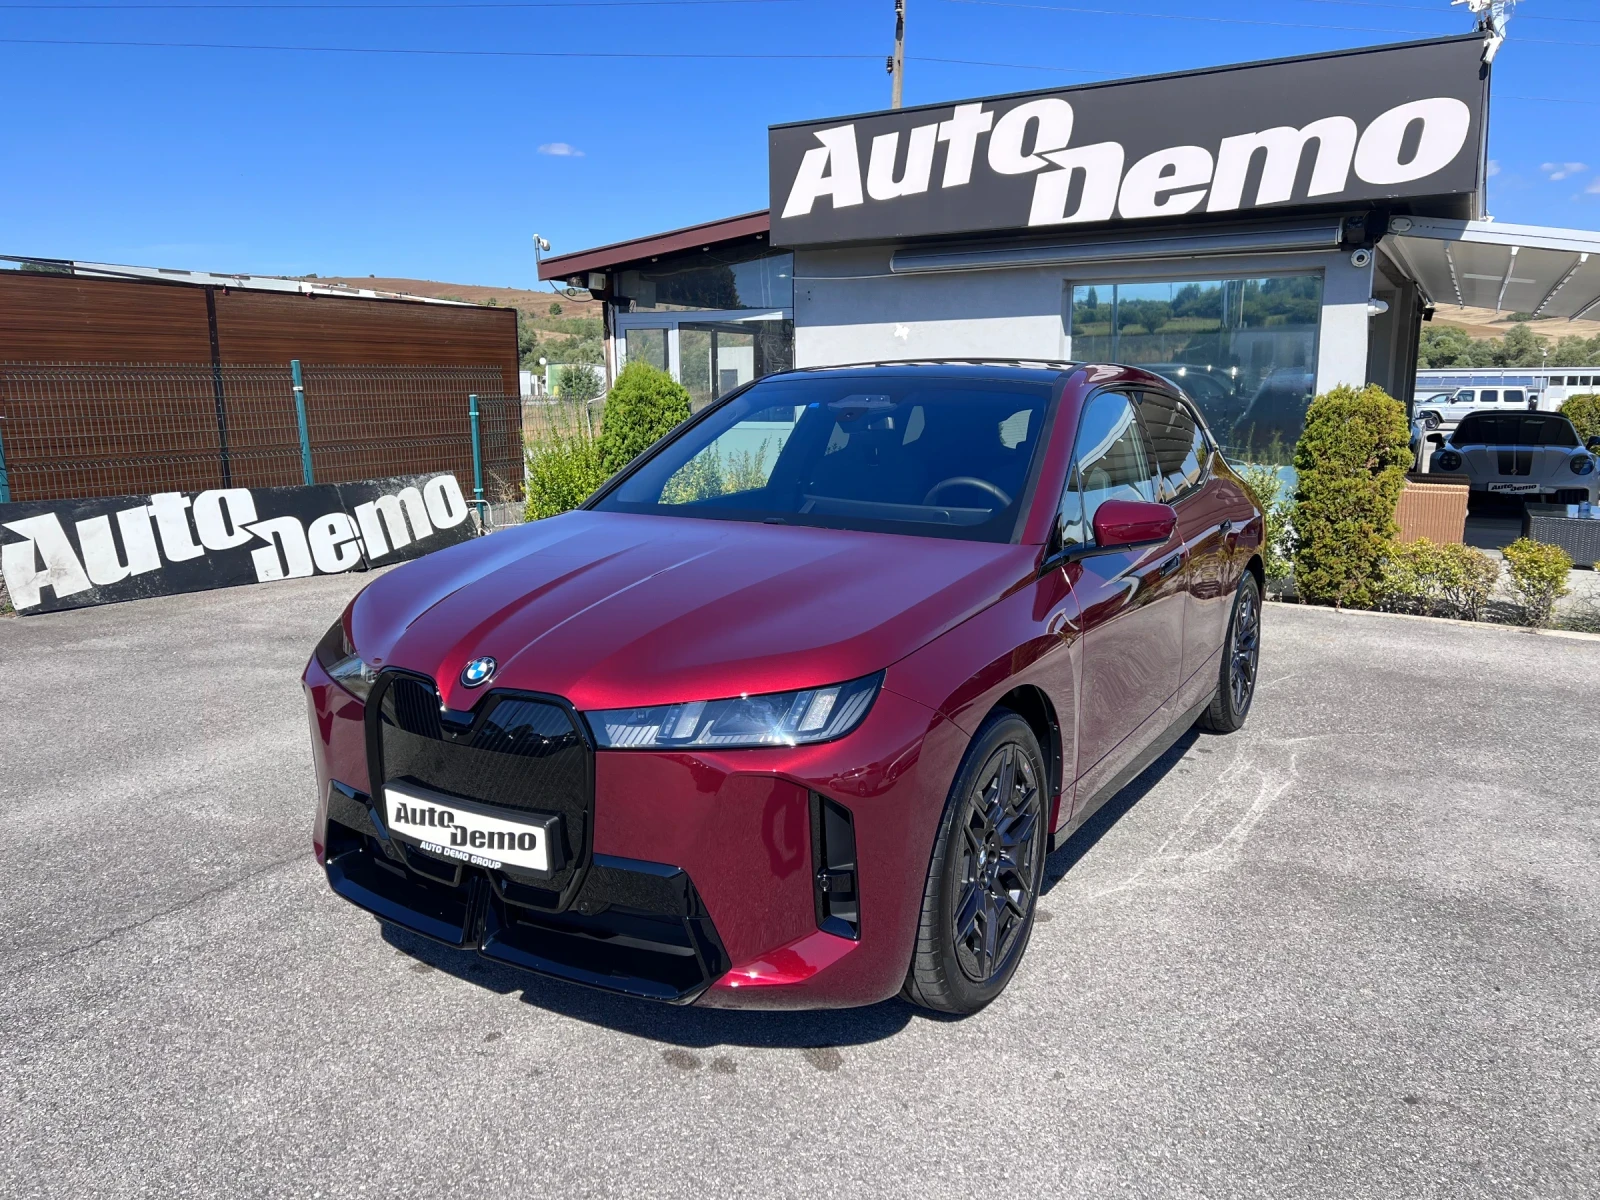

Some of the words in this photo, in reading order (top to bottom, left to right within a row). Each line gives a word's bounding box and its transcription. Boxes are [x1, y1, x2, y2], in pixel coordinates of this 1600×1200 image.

[781, 98, 1075, 218] Auto
[1028, 97, 1471, 227] Demo
[1, 488, 258, 611] Auto
[244, 475, 468, 583] Demo
[395, 802, 454, 828] Auto
[450, 825, 537, 851] Demo
[420, 841, 442, 853] AUTO
[444, 849, 469, 861] DEMO
[471, 856, 502, 869] GROUP
